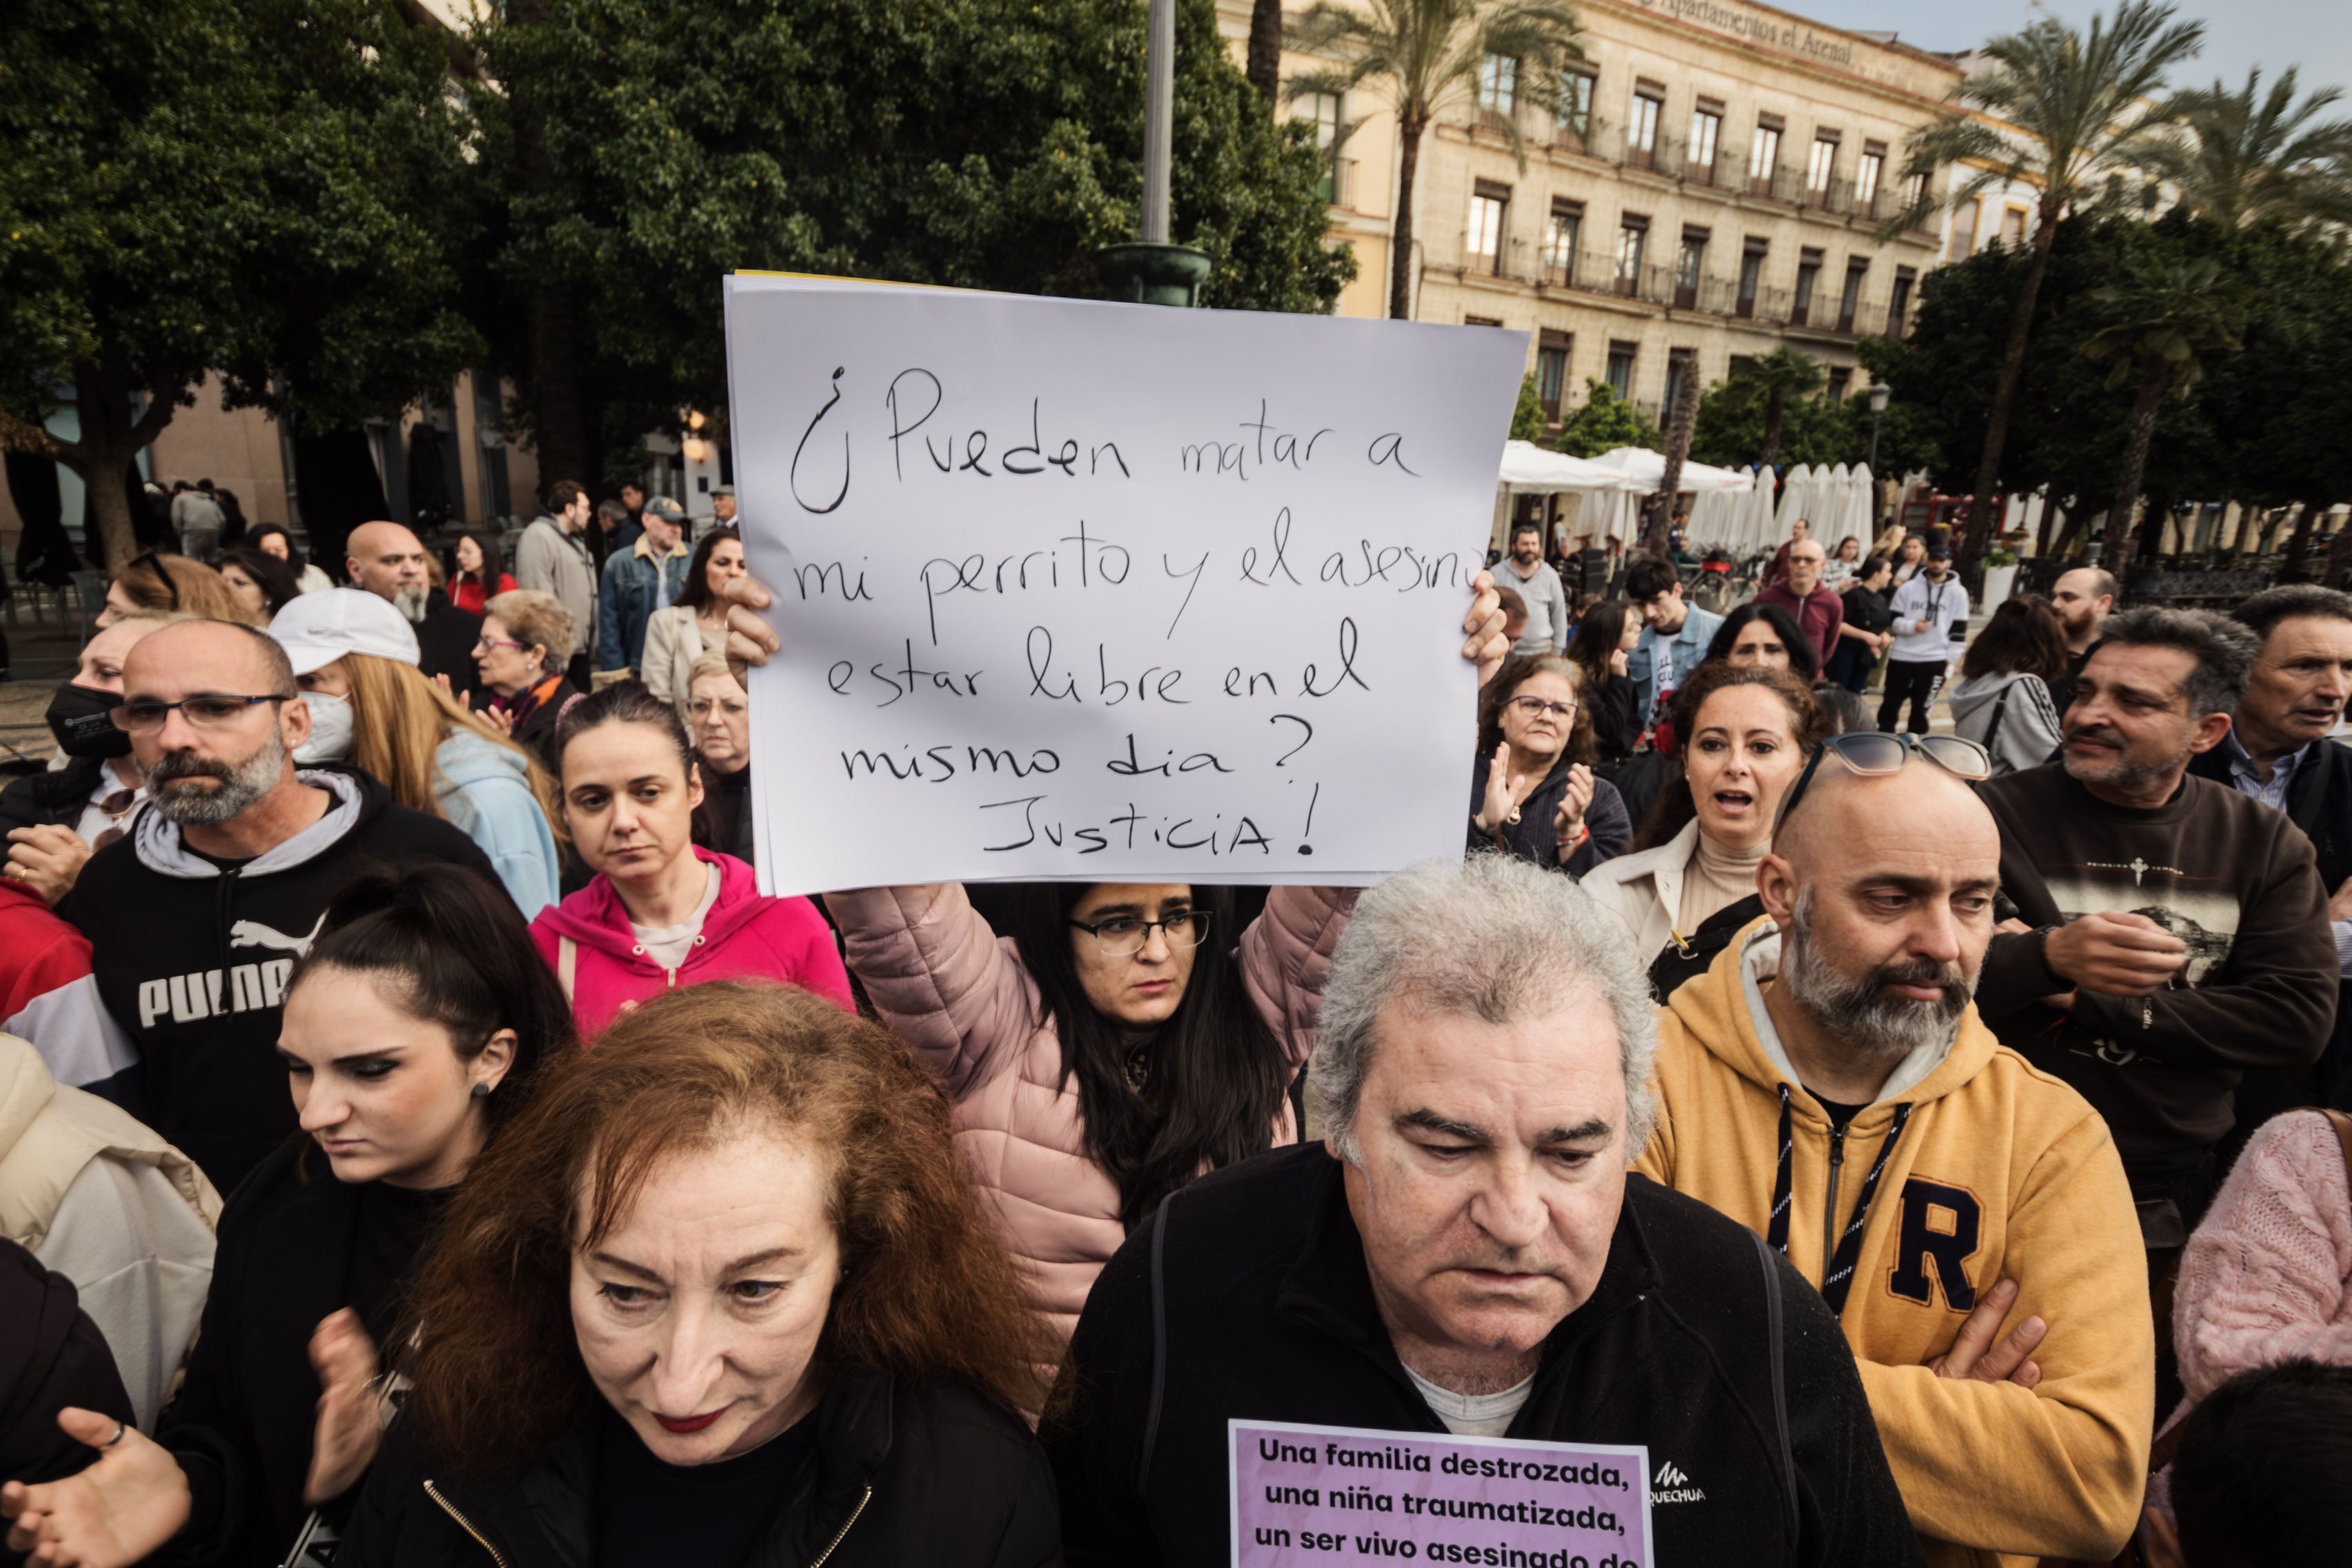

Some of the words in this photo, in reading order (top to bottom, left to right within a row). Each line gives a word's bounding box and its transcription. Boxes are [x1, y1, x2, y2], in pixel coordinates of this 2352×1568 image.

[1781, 23, 1798, 48] el
[1803, 32, 1854, 65] Arenal
[1182, 398, 1335, 482] matar
[1367, 431, 1422, 478] a
[793, 556, 874, 602] mi
[919, 519, 1131, 647] perrito
[1163, 550, 1211, 640] y
[1239, 506, 1303, 587] el
[1910, 600, 1948, 611] BOS
[827, 638, 985, 708] estar
[1026, 625, 1193, 707] libre
[1223, 665, 1279, 698] en
[1298, 616, 1372, 698] el
[841, 743, 1061, 783] mismo
[1887, 1173, 1985, 1313] R
[1260, 1438, 1317, 1464] Una
[1325, 1442, 1431, 1473] familia
[1440, 1452, 1629, 1492] destrozada,
[1265, 1484, 1320, 1507] una
[1329, 1484, 1393, 1512] niña
[1402, 1493, 1625, 1537] traumatizada,
[1255, 1527, 1291, 1548] un
[1300, 1531, 1347, 1552] ser
[1355, 1530, 1417, 1558] vivo
[1427, 1542, 1589, 1568] asesinado
